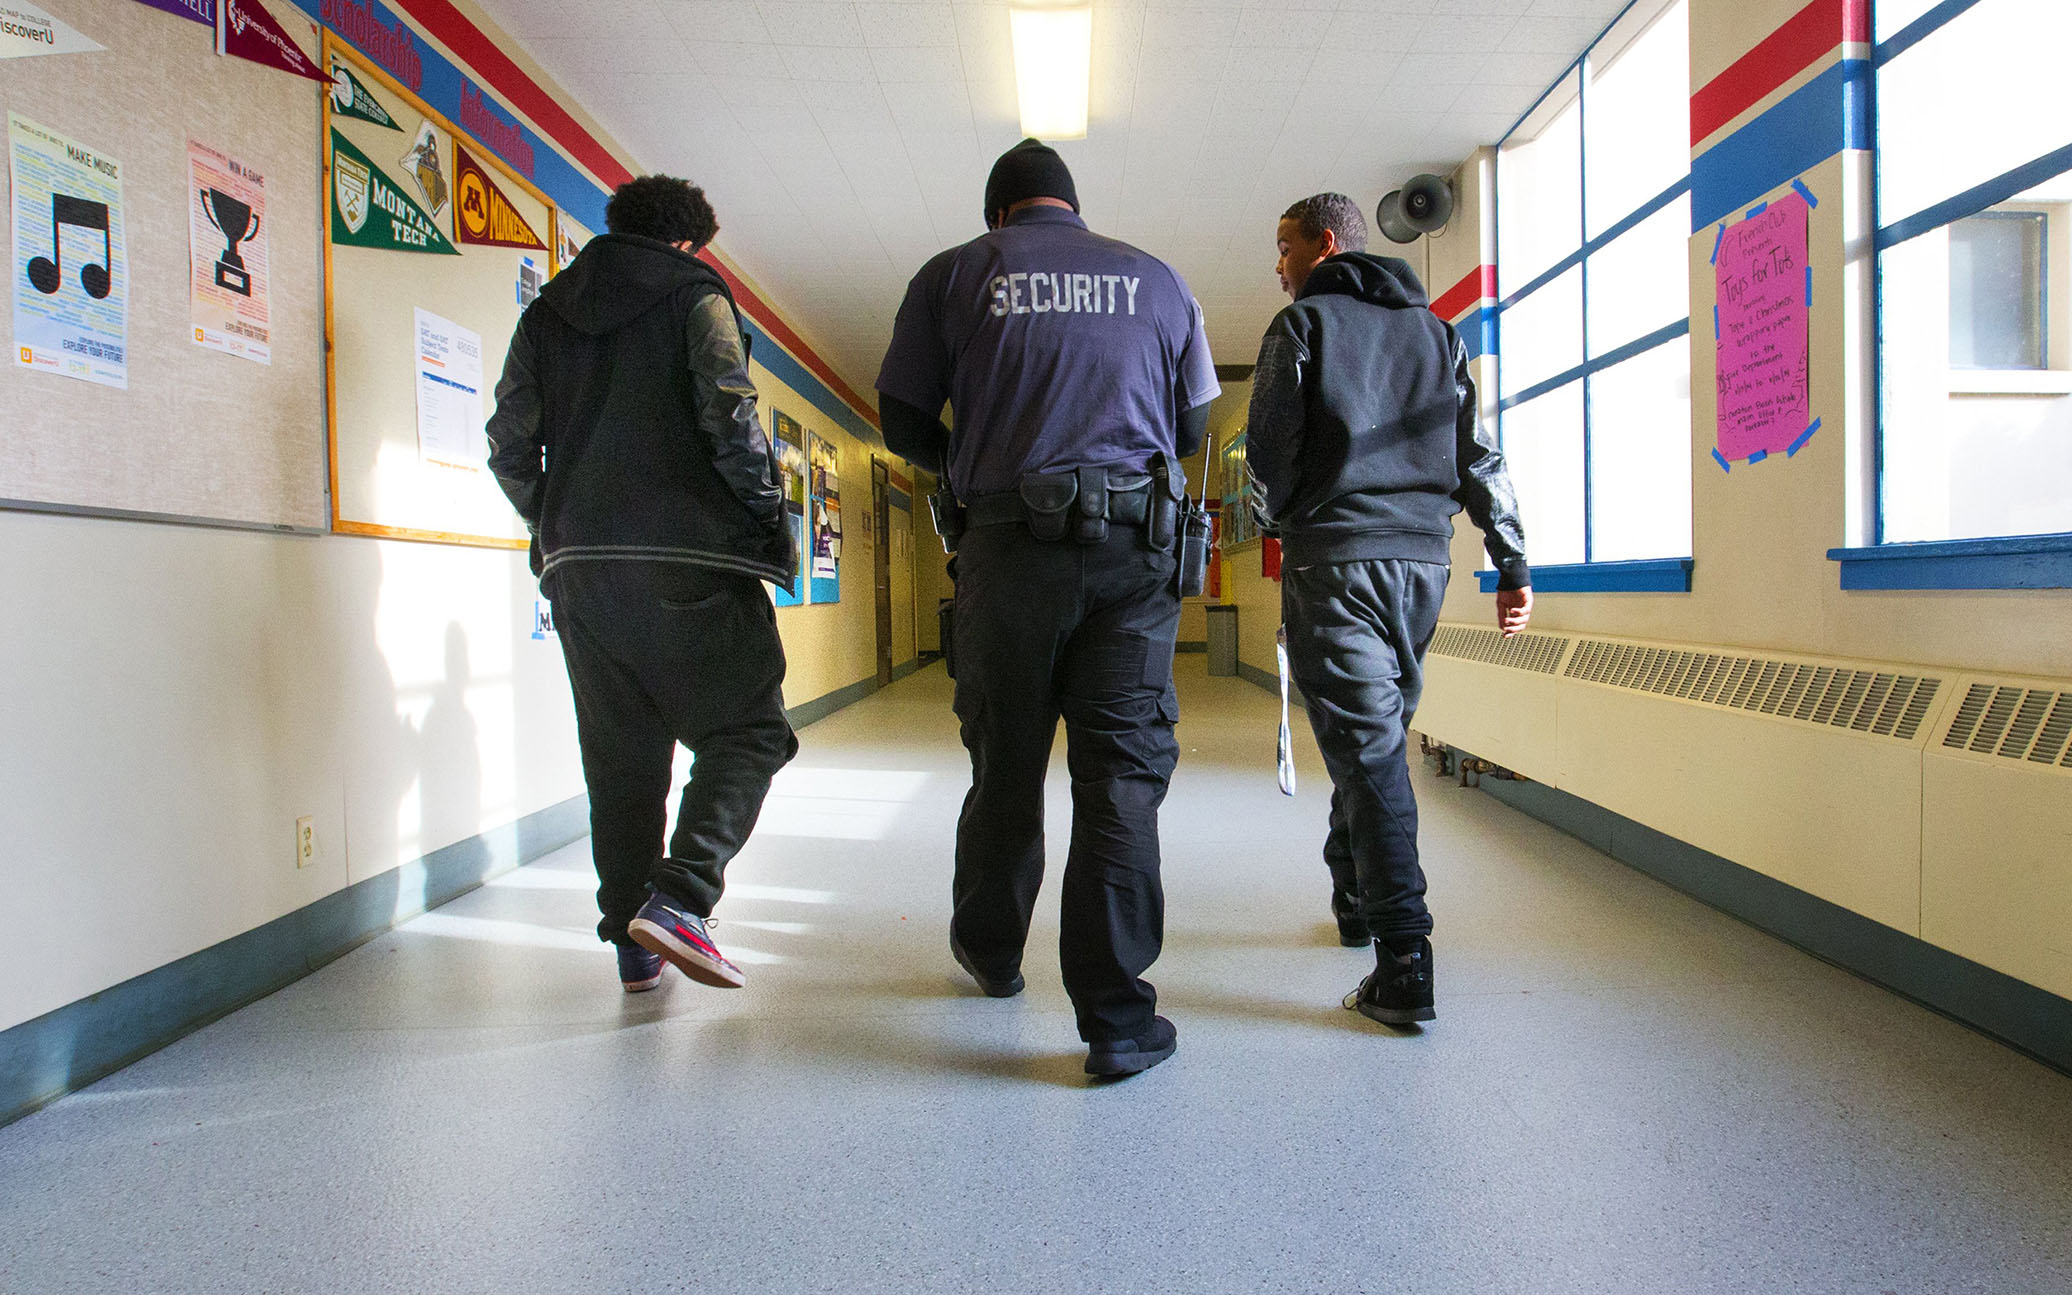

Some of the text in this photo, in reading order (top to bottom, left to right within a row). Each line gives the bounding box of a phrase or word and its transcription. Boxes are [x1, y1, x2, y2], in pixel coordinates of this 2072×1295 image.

[66, 144, 118, 180] MAKE MUSIC
[228, 160, 265, 188] WIN A GAME
[373, 176, 440, 242] MONTANA
[464, 185, 484, 220] M
[489, 186, 538, 246] MINNESOTA
[391, 218, 427, 246] TECH
[1721, 275, 1749, 307] Toys
[1752, 258, 1768, 284] for
[1768, 244, 1794, 277] Tots
[989, 272, 1140, 317] SECURITY
[63, 339, 88, 354] EXPLORE
[88, 346, 103, 358] YOUR
[104, 350, 123, 364] FUTURE
